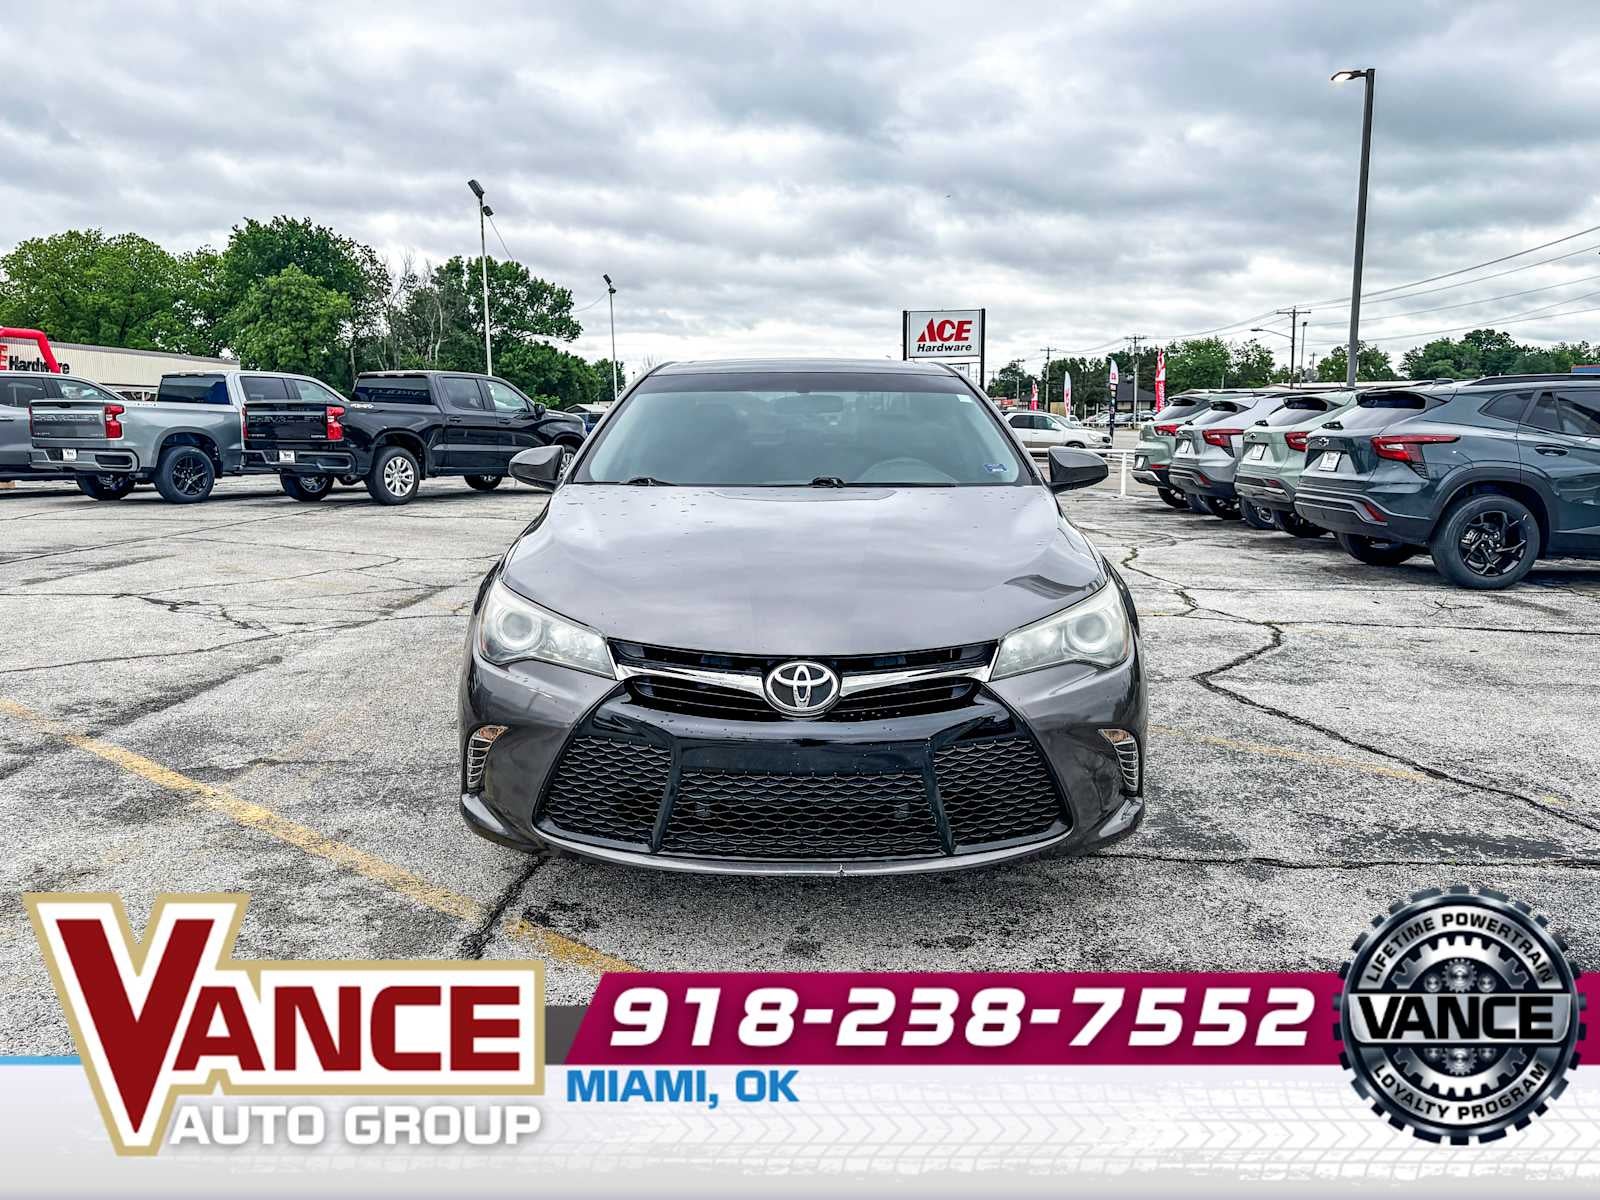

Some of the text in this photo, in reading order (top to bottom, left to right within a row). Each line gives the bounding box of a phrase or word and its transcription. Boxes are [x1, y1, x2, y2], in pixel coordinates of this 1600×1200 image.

[916, 317, 973, 343] ACE
[916, 343, 972, 353] Hardware
[9, 355, 70, 375] Hardwre
